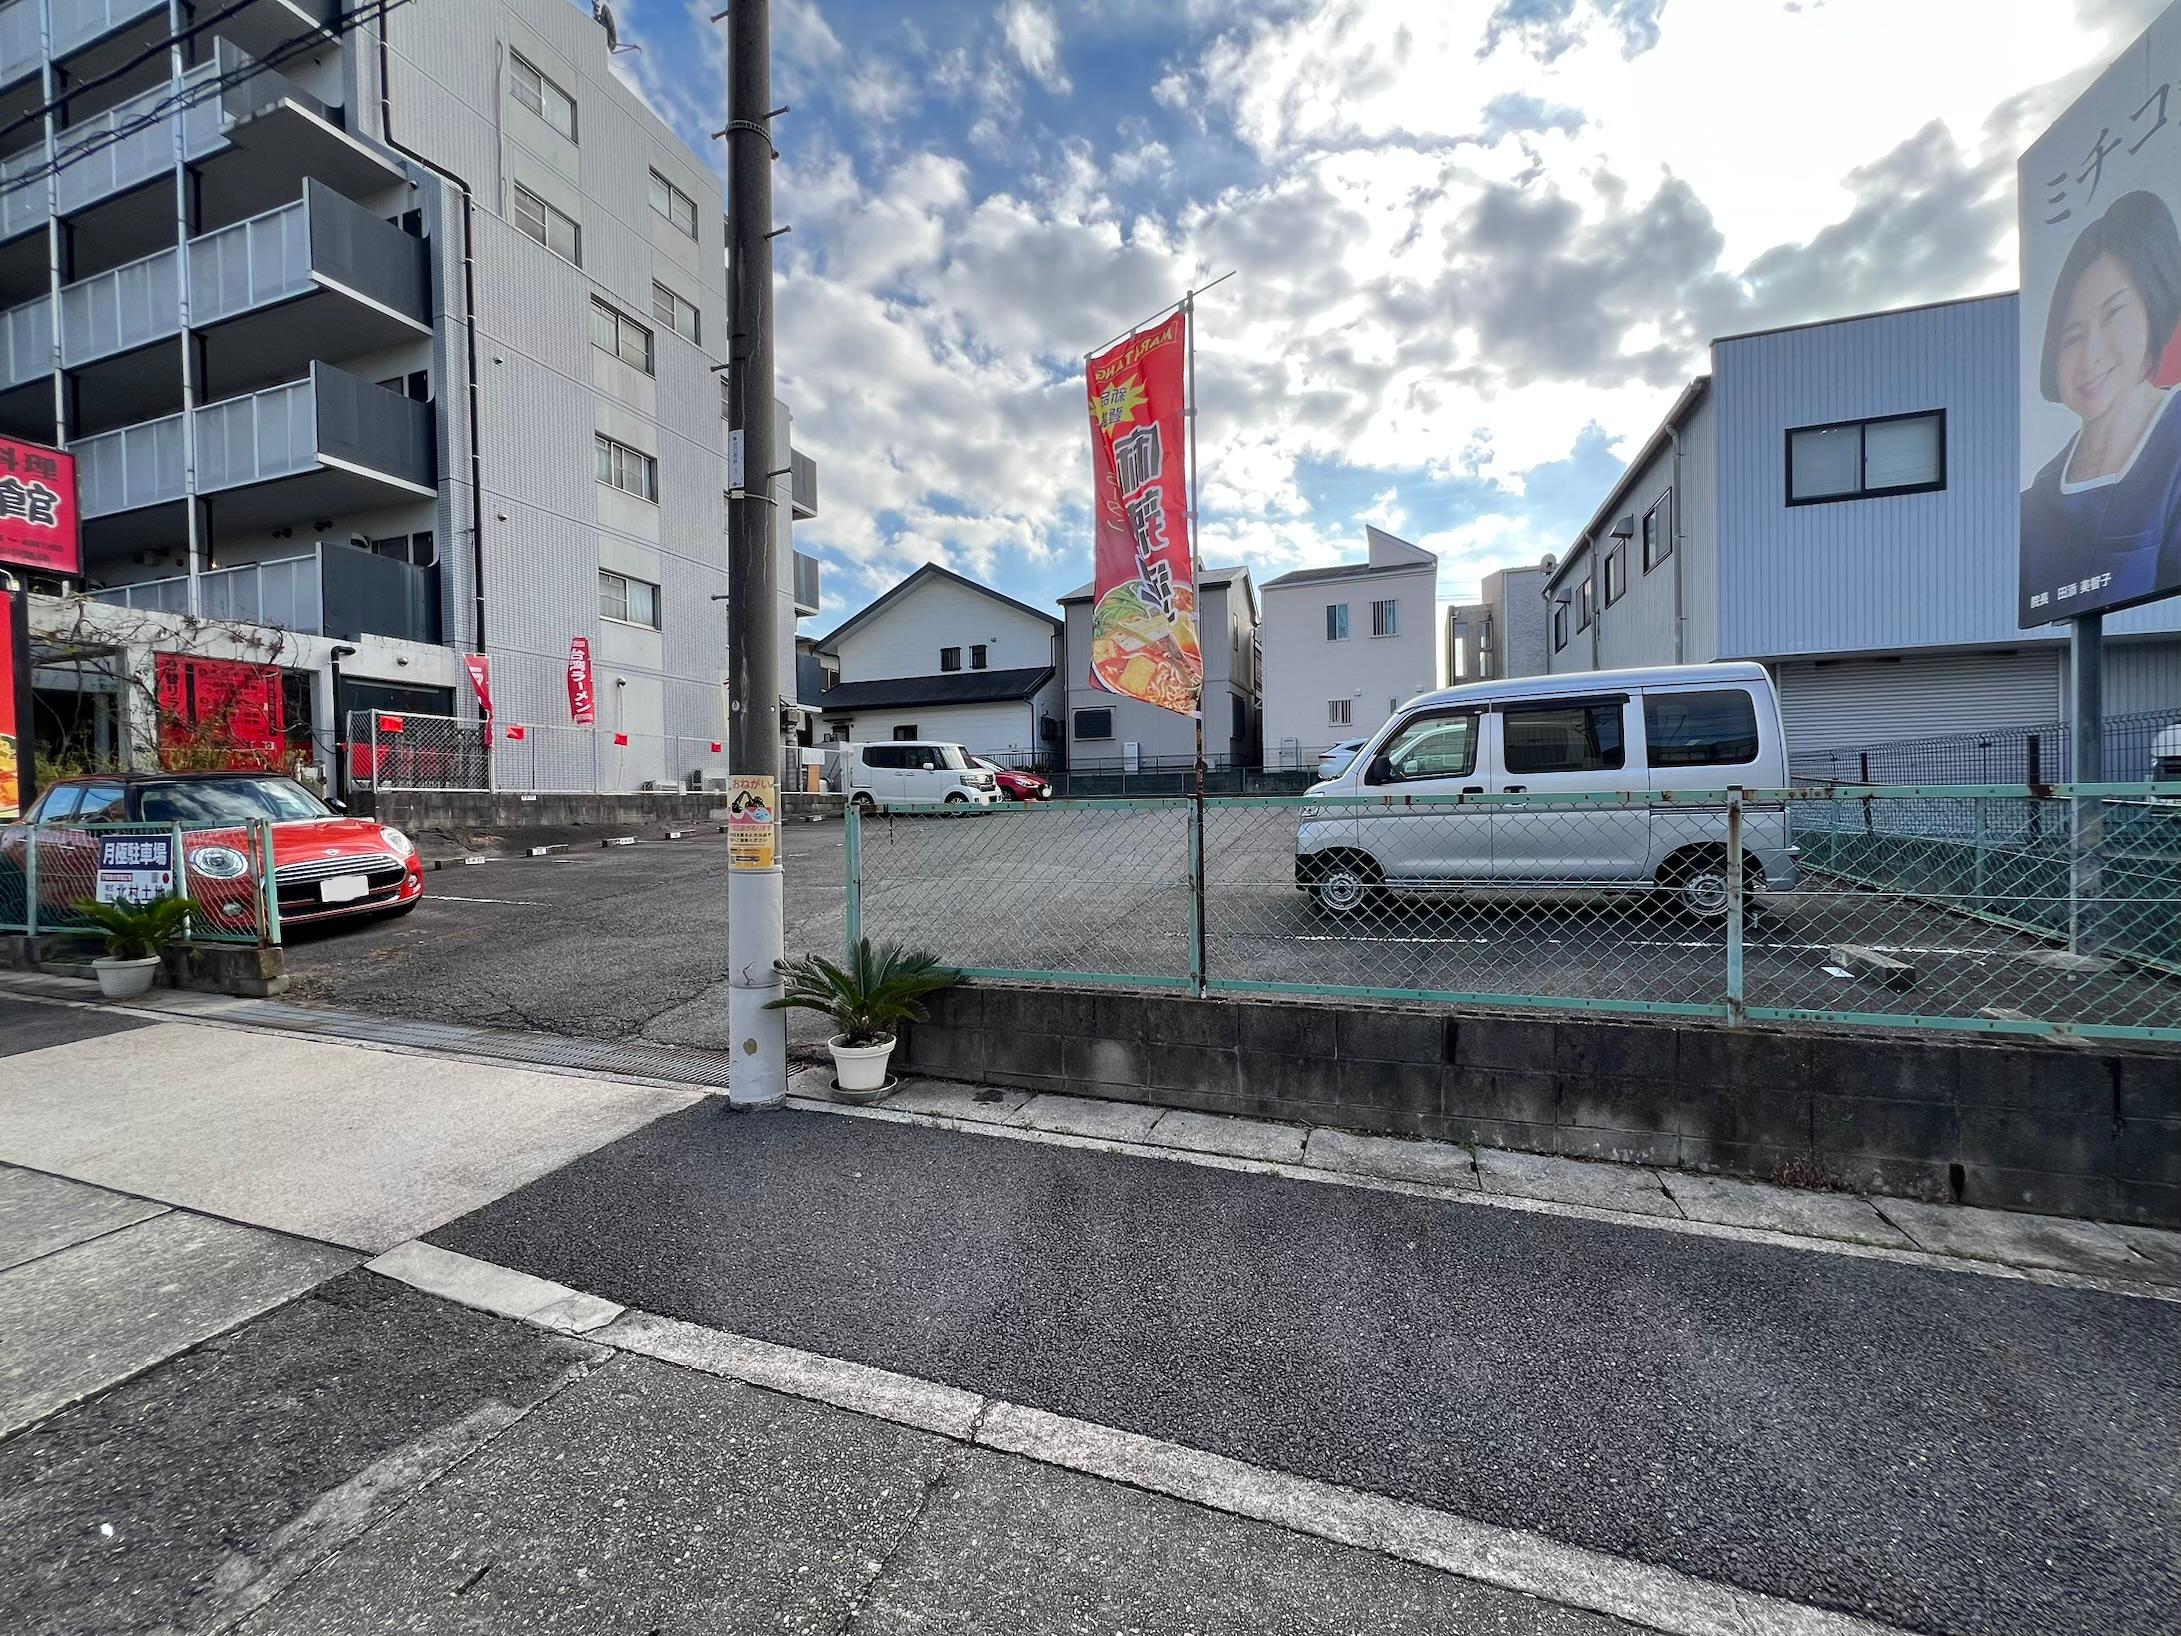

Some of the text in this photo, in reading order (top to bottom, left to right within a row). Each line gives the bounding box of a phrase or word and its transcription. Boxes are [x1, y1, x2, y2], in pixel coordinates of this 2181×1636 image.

[2044, 80, 2181, 225] ミチコ
[103, 842, 167, 866] 月極駐車場
